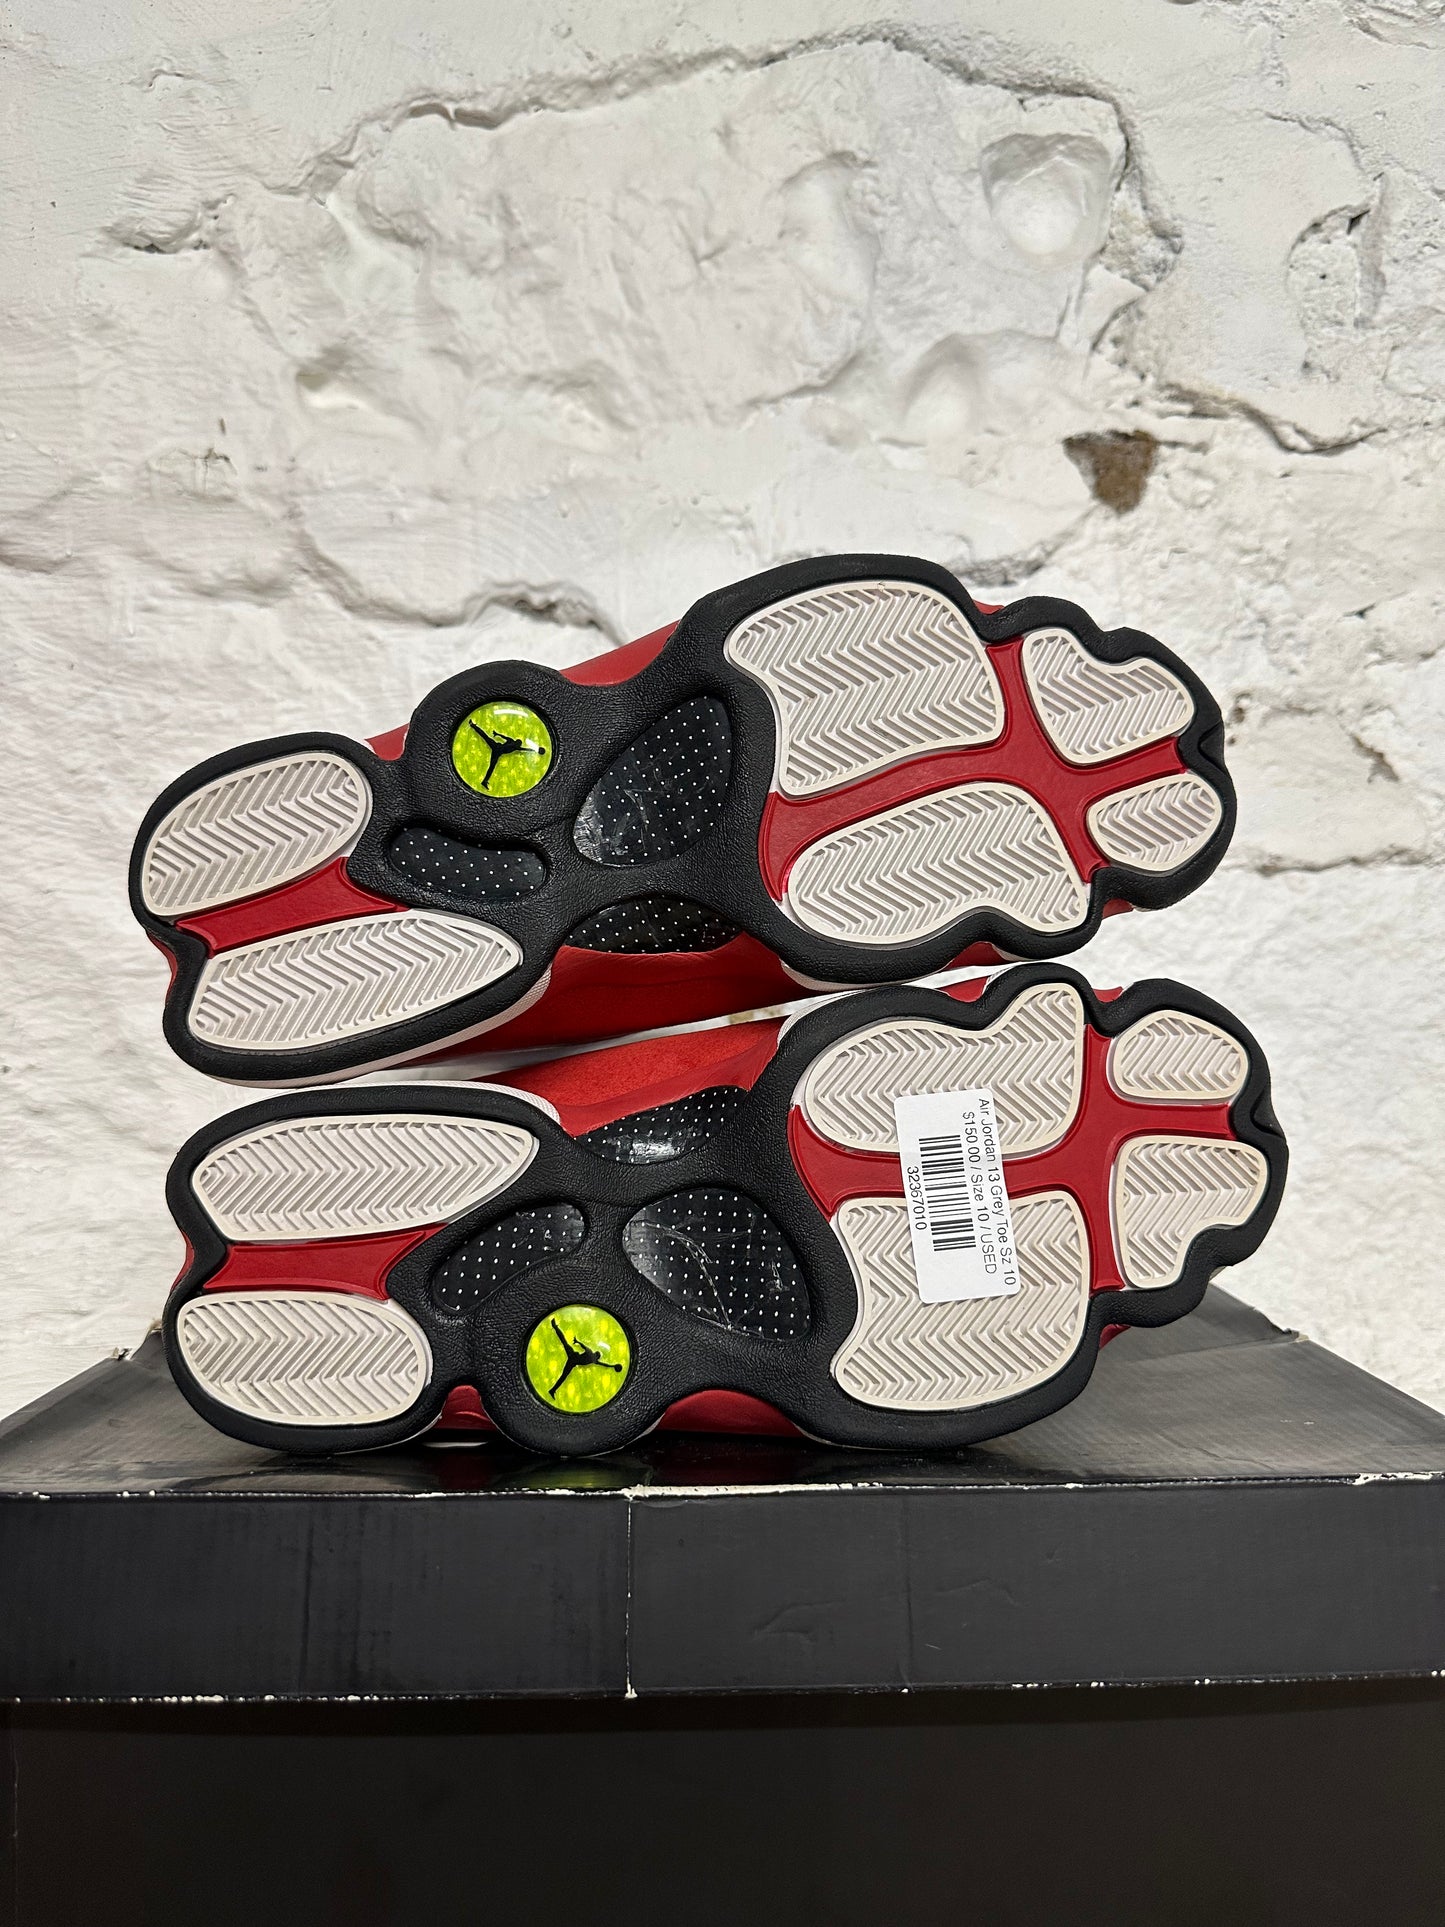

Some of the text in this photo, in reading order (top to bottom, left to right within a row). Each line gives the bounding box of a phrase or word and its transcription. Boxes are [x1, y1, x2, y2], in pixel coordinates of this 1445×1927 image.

[907, 1166, 927, 1230] 32367010
[971, 1174, 984, 1201] Size
[979, 1098, 1016, 1285] Air Jordan 13 Grey Toe Sz 10
[977, 1206, 989, 1221] 10
[980, 1233, 997, 1274] USED
